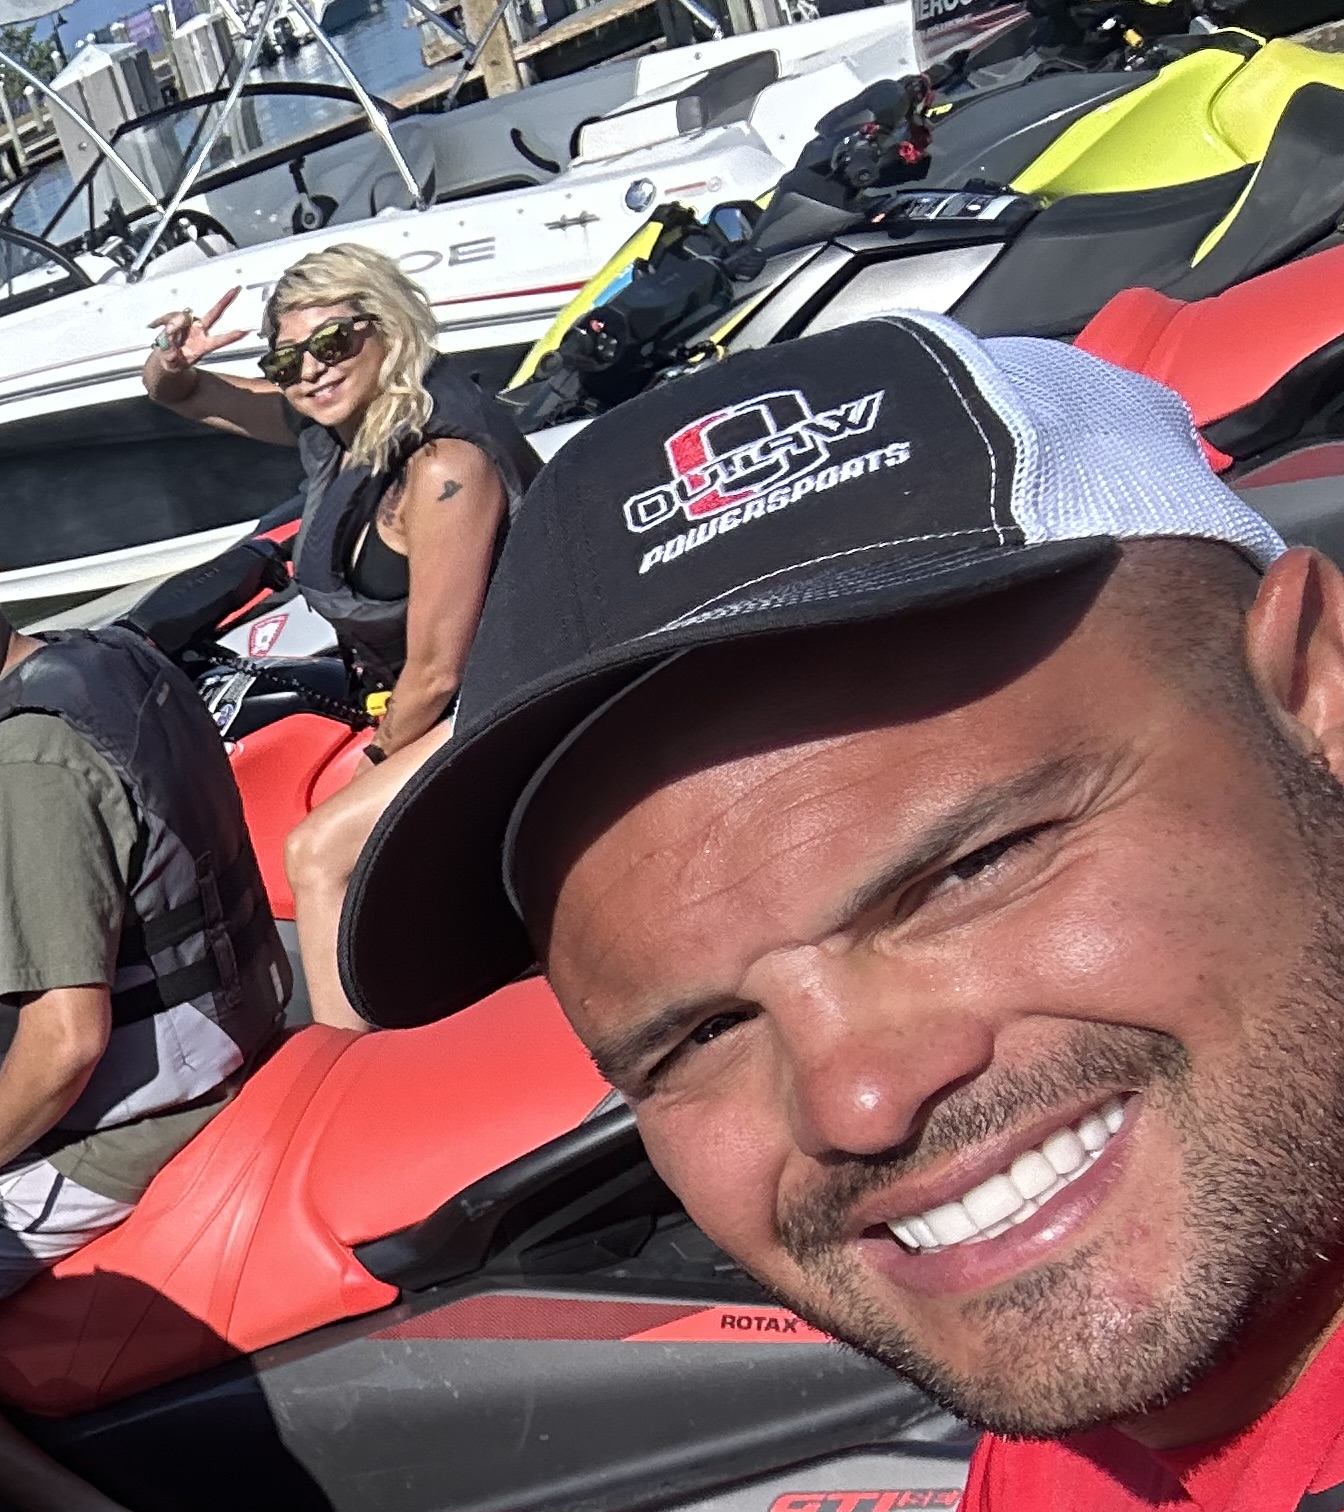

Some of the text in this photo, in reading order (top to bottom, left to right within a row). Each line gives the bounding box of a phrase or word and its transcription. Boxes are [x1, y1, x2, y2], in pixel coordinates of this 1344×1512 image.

[246, 236, 496, 302] TOE
[638, 441, 912, 575] POWERSPORTS
[720, 1313, 800, 1334] ROTAX
